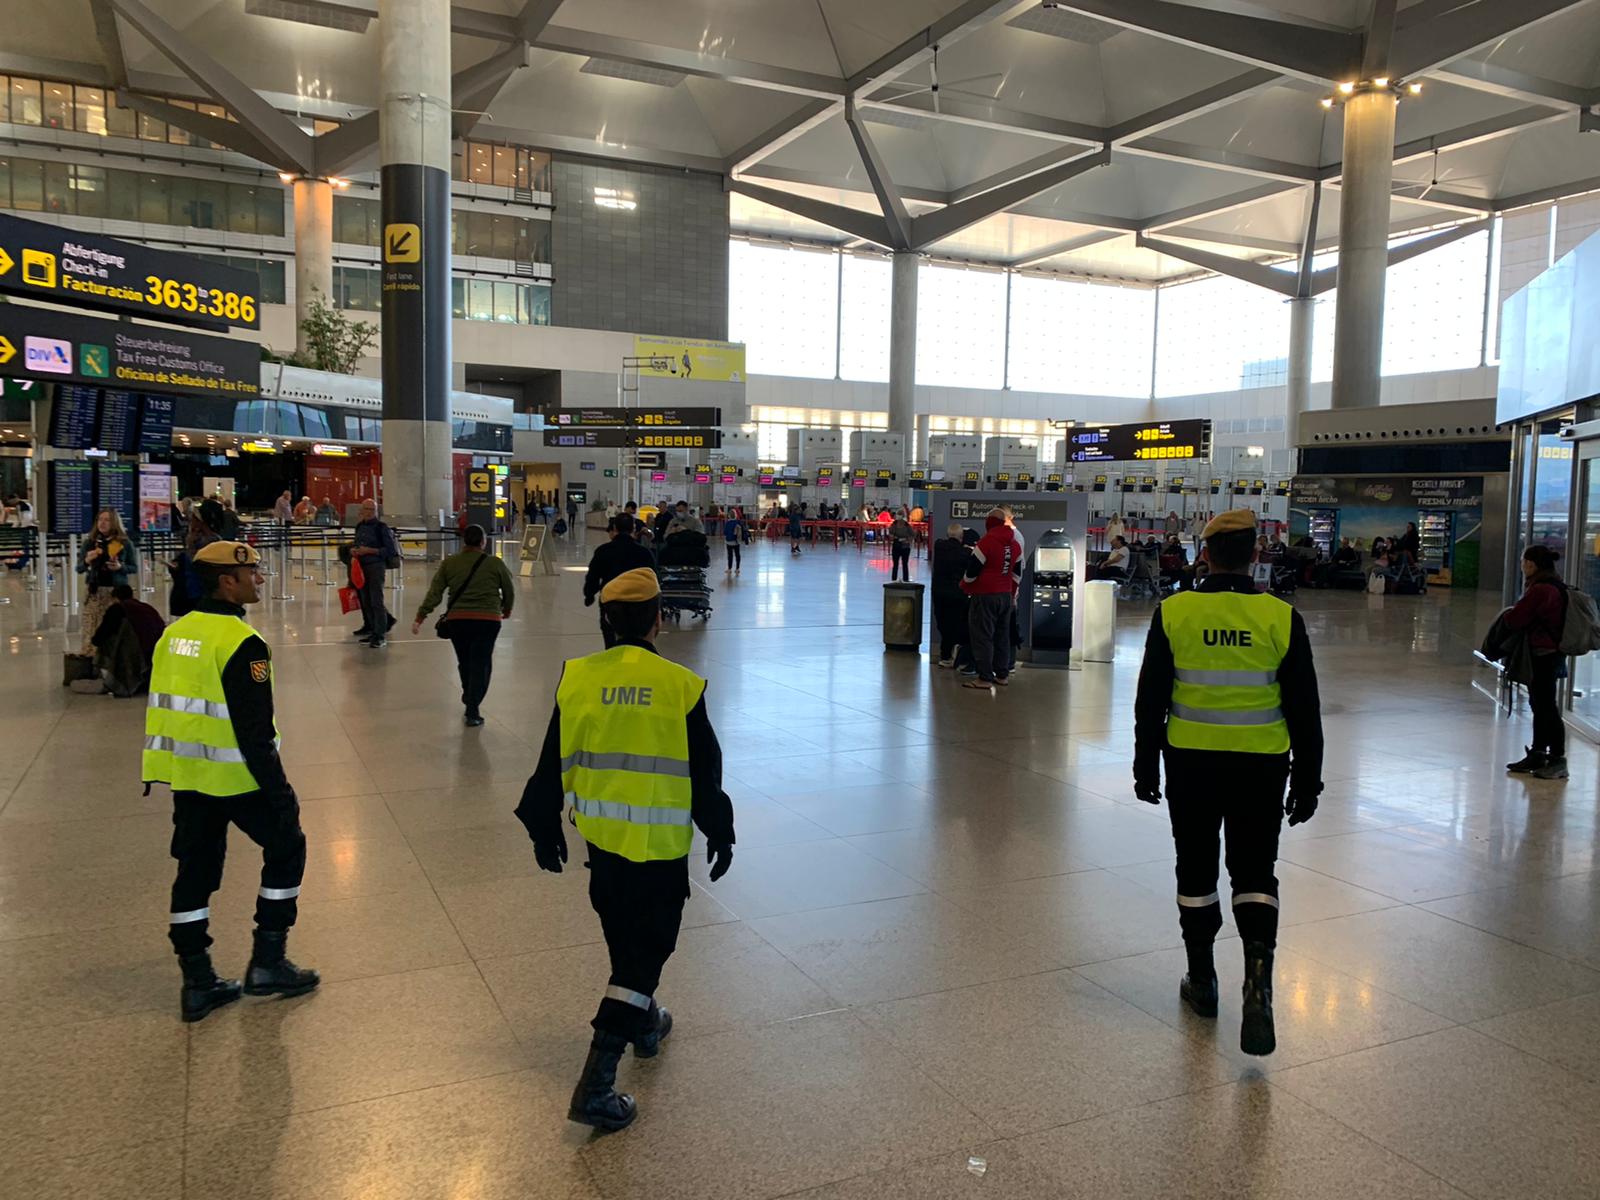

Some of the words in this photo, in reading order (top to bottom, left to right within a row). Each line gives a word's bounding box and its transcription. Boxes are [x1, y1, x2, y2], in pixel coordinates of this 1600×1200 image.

[63, 242, 126, 269] Abfertigung
[62, 258, 108, 278] Check-in
[398, 272, 413, 280] lane
[63, 274, 143, 302] Facturación
[145, 275, 198, 312] 363
[198, 286, 208, 298] to
[199, 304, 207, 313] a
[208, 288, 255, 322] 386
[115, 333, 191, 358] Steuerbefreiung
[116, 349, 133, 363] Tax
[135, 352, 157, 366] Free
[159, 355, 198, 370] Customs
[200, 360, 224, 374] Office
[116, 366, 154, 382] Oficina
[156, 371, 168, 383] de
[170, 372, 205, 387] Sellado
[207, 377, 218, 389] de
[219, 378, 236, 391] Tax
[238, 381, 257, 393] Free
[697, 464, 710, 472] 364
[723, 465, 736, 473] 365
[1203, 629, 1252, 647] UME
[601, 686, 652, 706] UME
